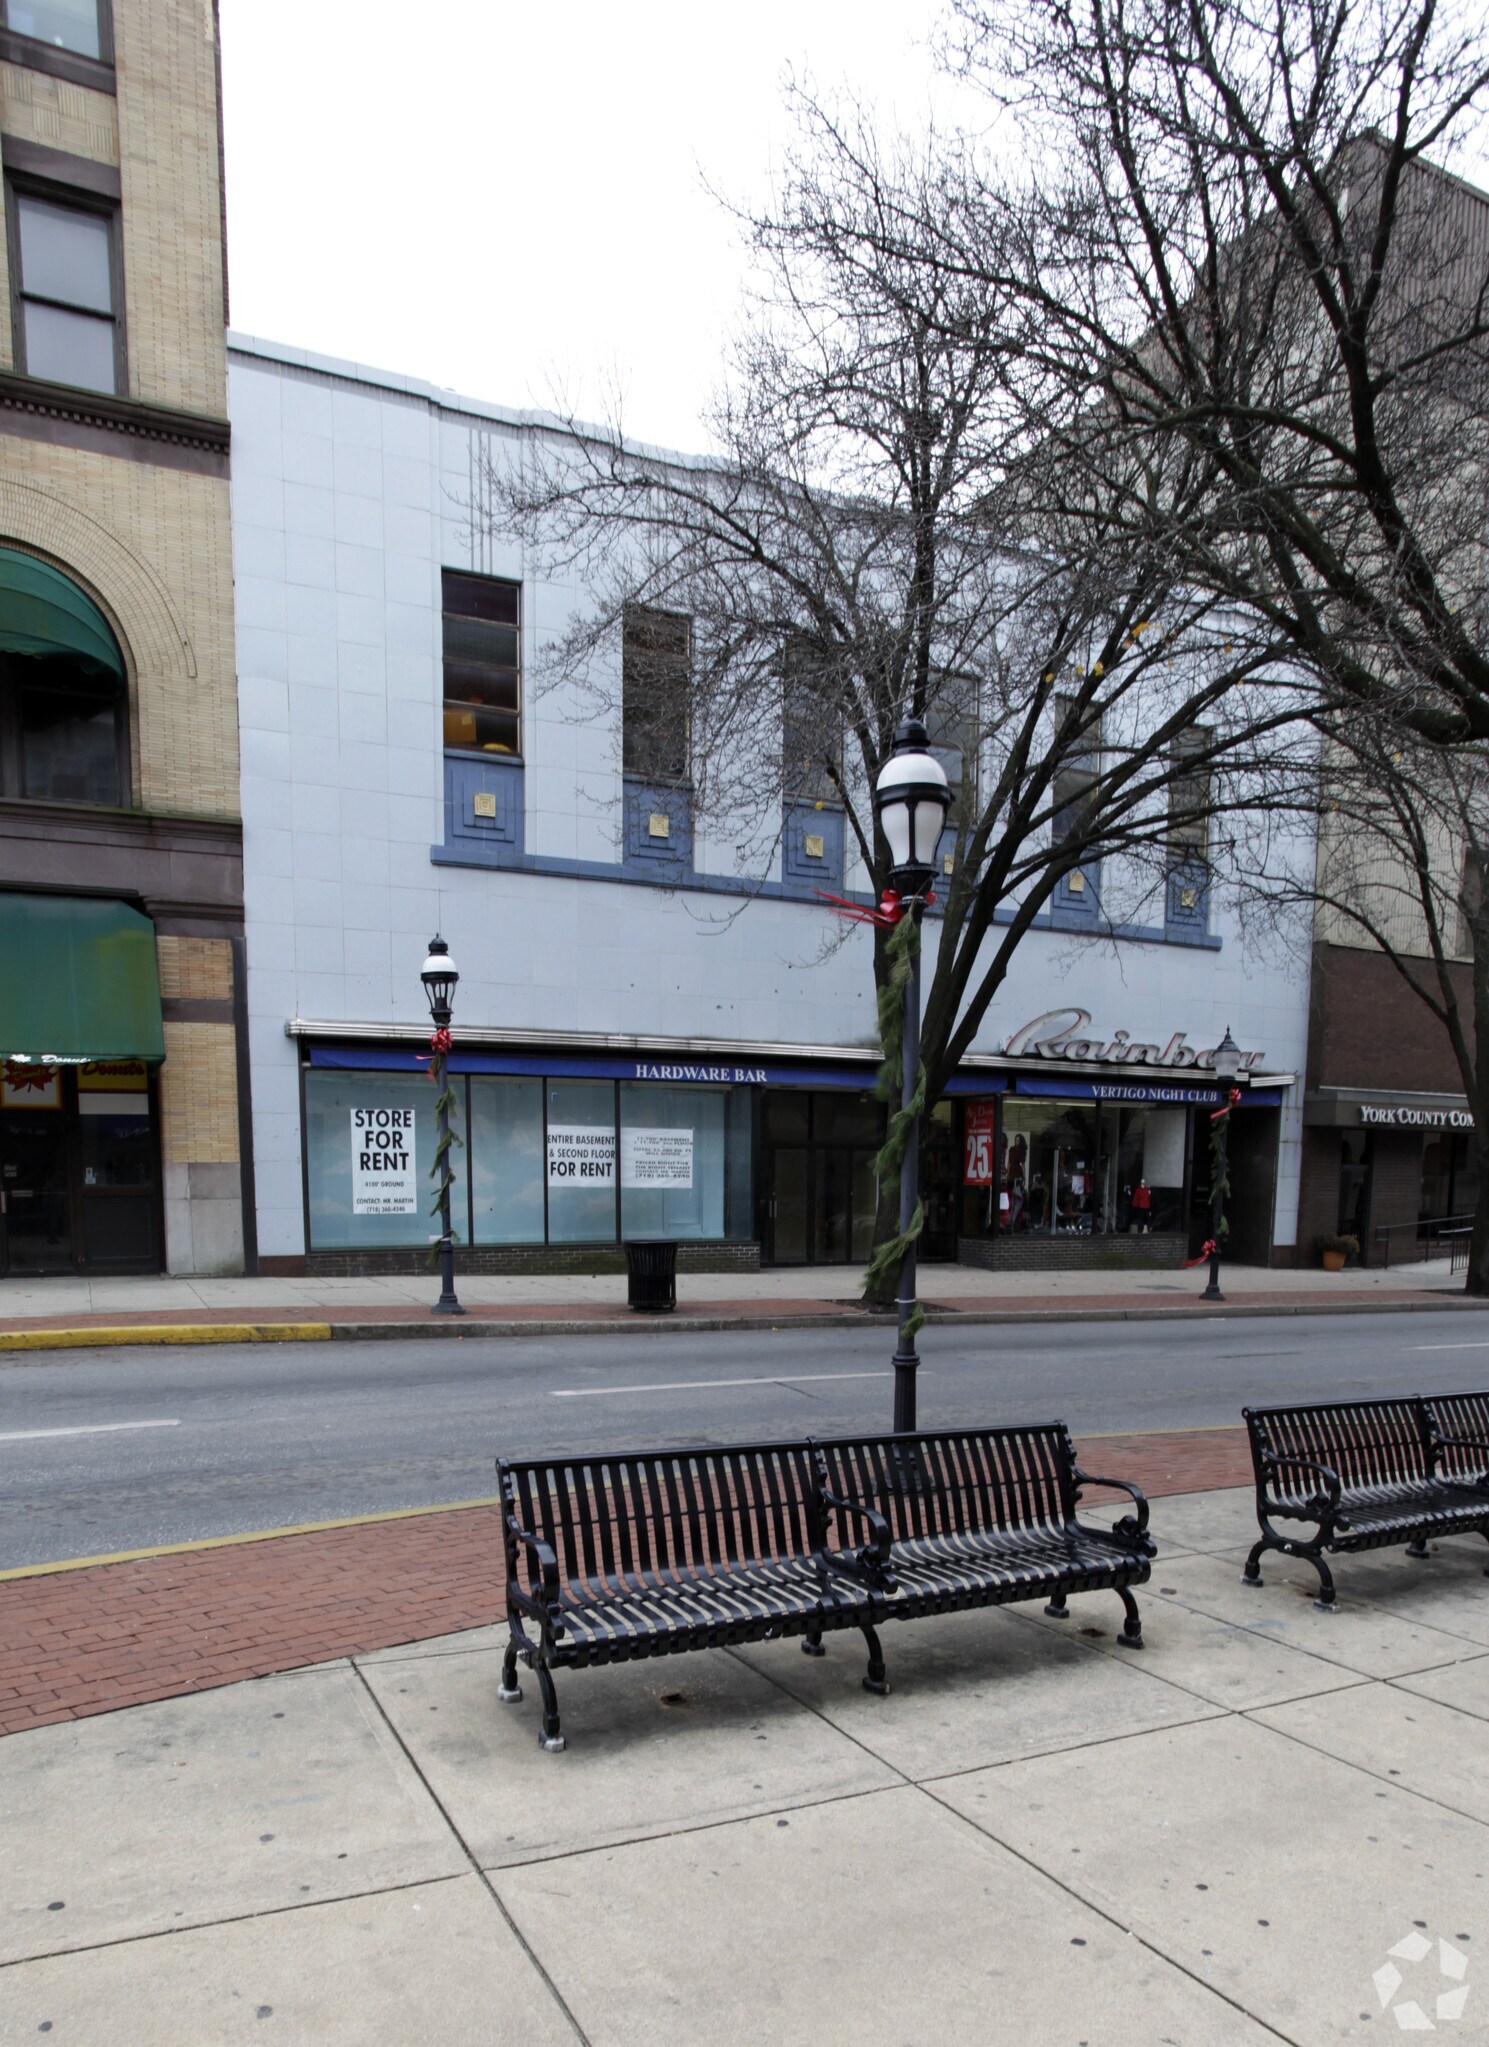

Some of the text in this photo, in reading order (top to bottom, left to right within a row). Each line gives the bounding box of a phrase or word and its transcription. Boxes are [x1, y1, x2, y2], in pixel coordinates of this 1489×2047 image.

[635, 1064, 767, 1082] HARDWARE BAR
[1092, 1085, 1217, 1102] VERTIGO NIGHT CLUB
[355, 1109, 412, 1128] STORE
[1361, 1105, 1396, 1123] YORK
[1397, 1107, 1447, 1126] COUNTY
[365, 1130, 403, 1150] FOR
[547, 1134, 615, 1146] ENTIRE BASEMENT
[360, 1152, 409, 1171] RENT
[549, 1148, 615, 1159] & SECOND FLOOR
[550, 1161, 612, 1177] FOR RENT
